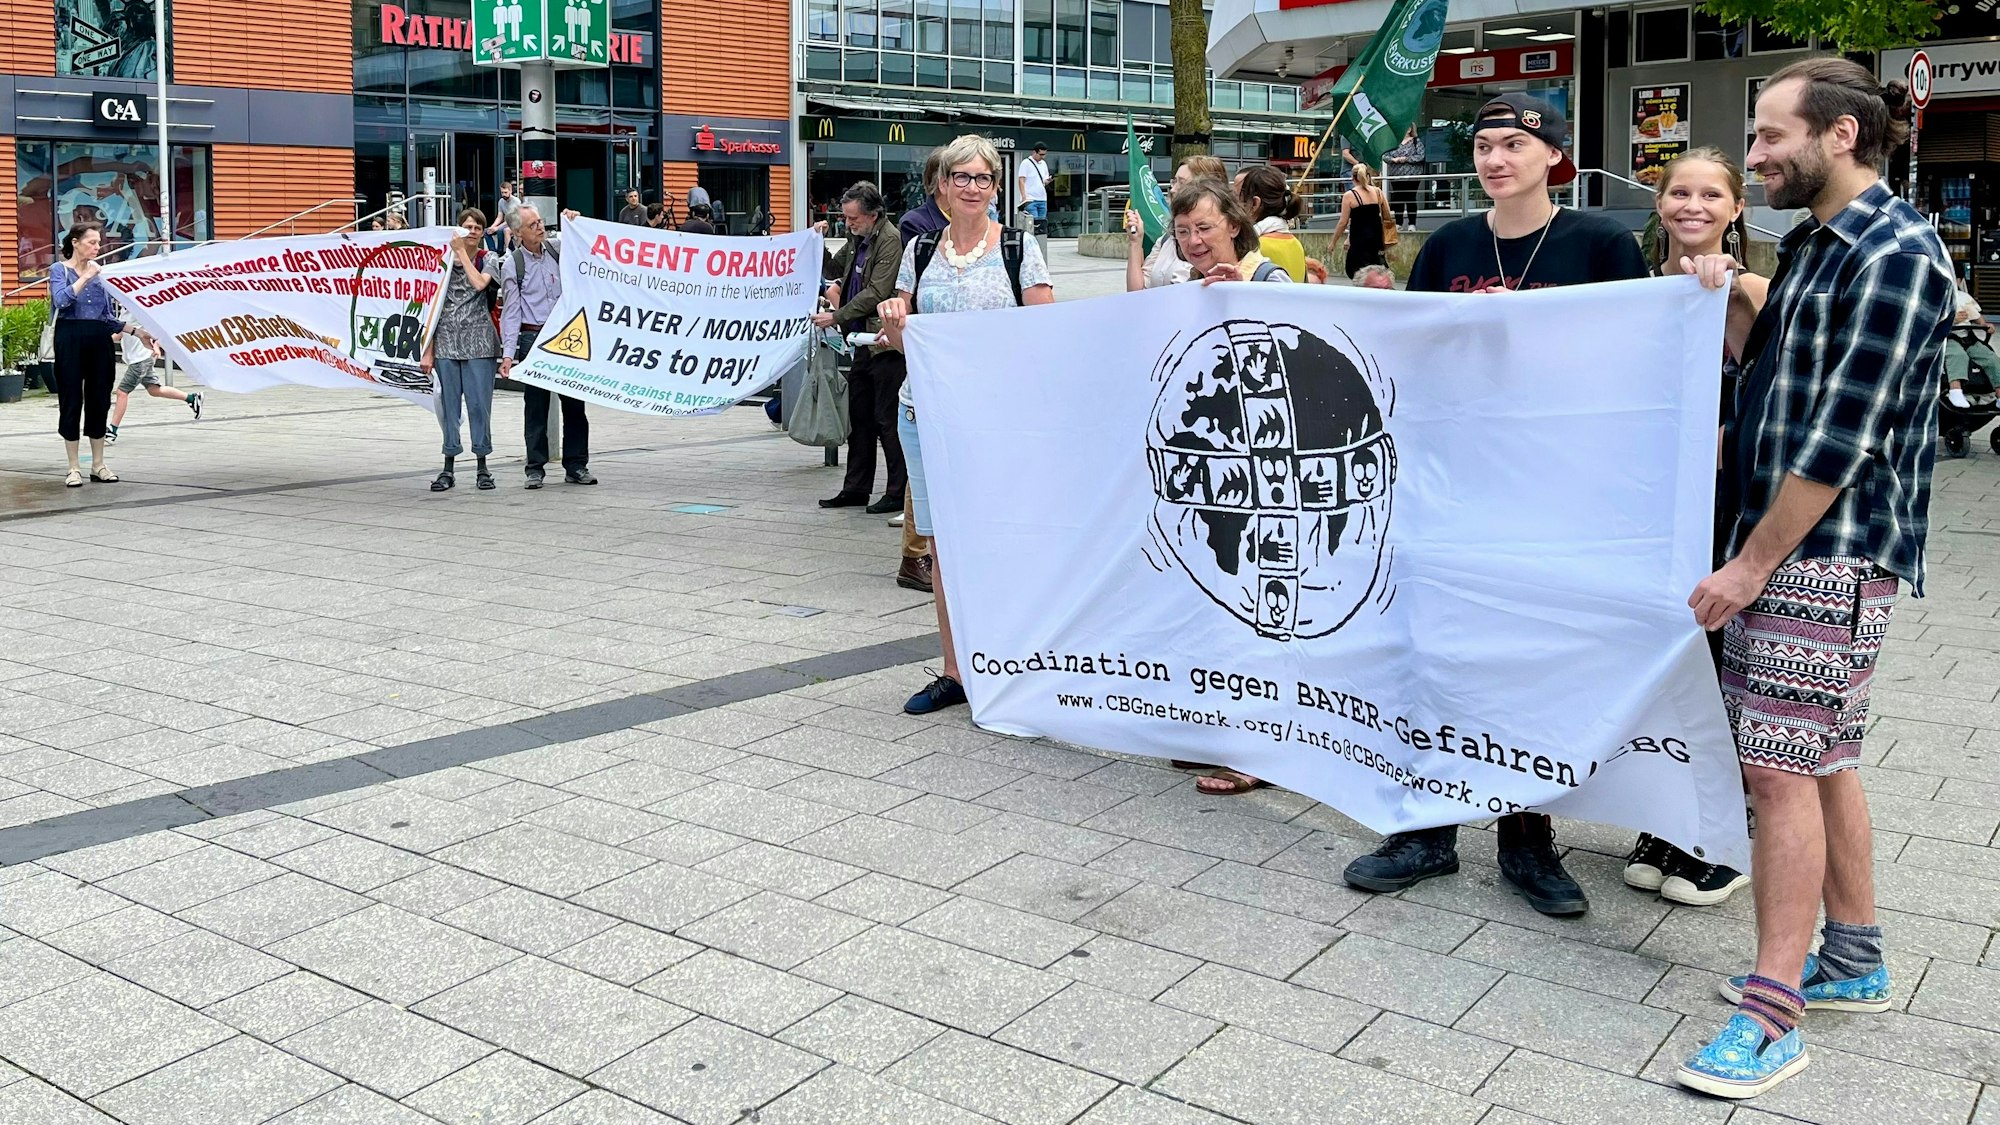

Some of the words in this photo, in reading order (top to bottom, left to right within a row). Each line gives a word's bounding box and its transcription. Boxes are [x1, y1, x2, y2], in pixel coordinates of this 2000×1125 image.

[79, 25, 94, 38] ONE
[78, 54, 91, 65] ONE
[97, 46, 113, 58] WAY
[1470, 64, 1484, 73] ITS
[101, 98, 140, 121] C&A
[719, 139, 780, 155] Sparkasse
[282, 248, 321, 273] des
[591, 234, 699, 273] AGENT
[706, 248, 796, 278] ORANGE
[249, 276, 303, 293] contre
[303, 276, 332, 294] les
[394, 278, 411, 301] de
[578, 261, 642, 287] Chemical
[647, 275, 702, 296] Weapon
[706, 282, 717, 297] in
[721, 282, 740, 299] the
[744, 284, 783, 300] Vietnam
[597, 300, 683, 336] BAYER
[685, 317, 701, 337] /
[607, 337, 662, 370] has
[668, 348, 698, 377] to
[702, 354, 760, 386] pay!
[621, 382, 672, 401] against
[1190, 666, 1279, 701] gegen
[1297, 681, 1580, 788] BAYER-Gefahren
